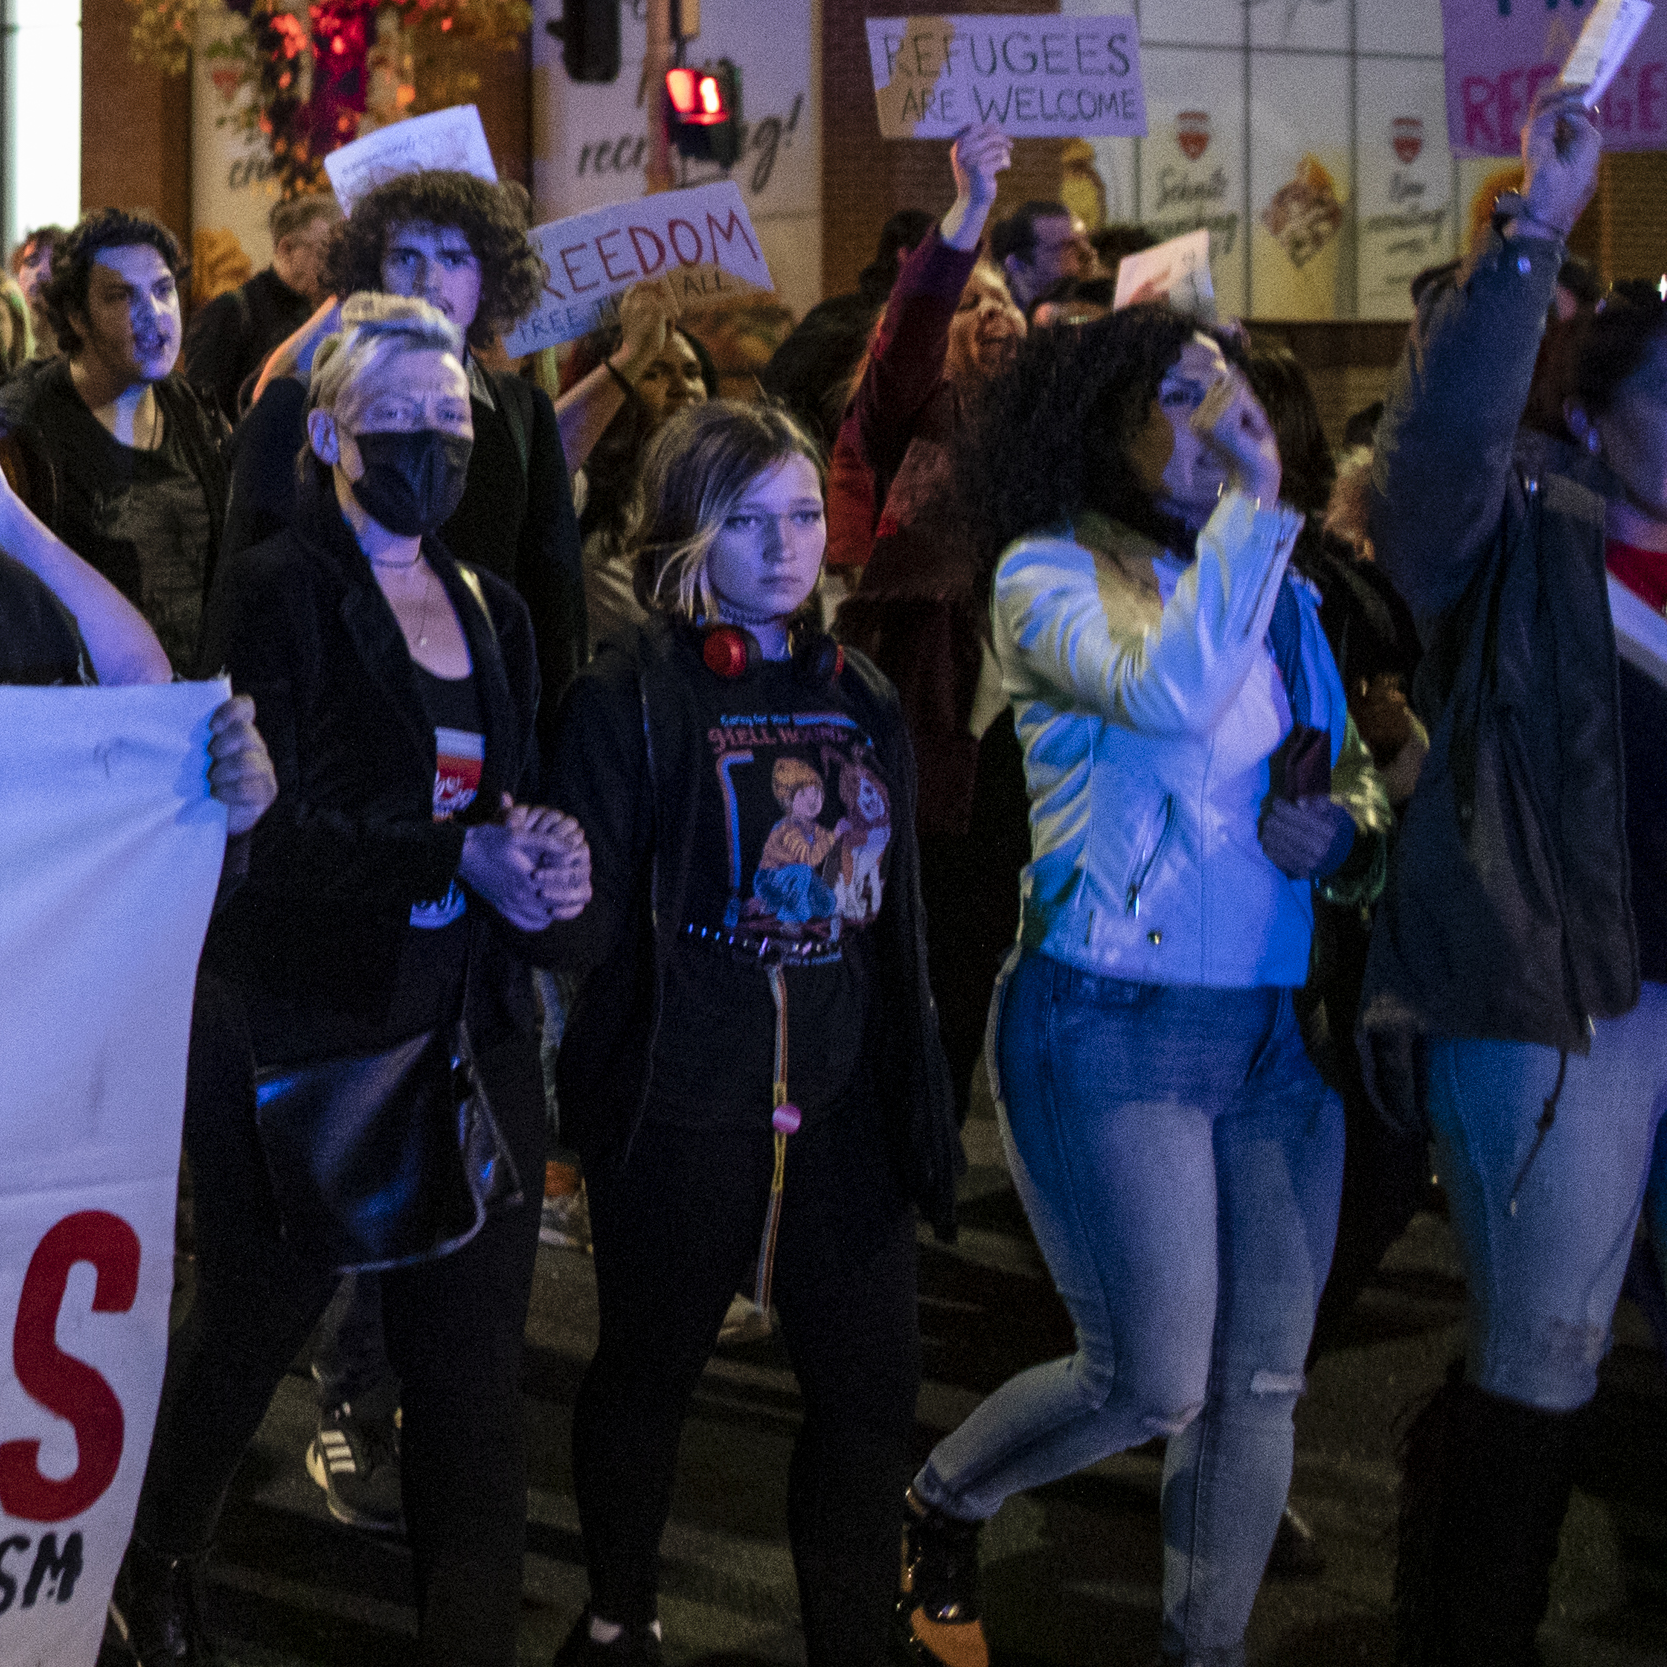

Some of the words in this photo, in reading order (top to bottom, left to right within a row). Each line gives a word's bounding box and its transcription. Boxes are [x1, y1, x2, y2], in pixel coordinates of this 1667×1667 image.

[883, 32, 1131, 77] REFUGEES
[902, 87, 957, 123] ARE
[972, 84, 1138, 125] WELCOME
[543, 209, 759, 301] EEDOM
